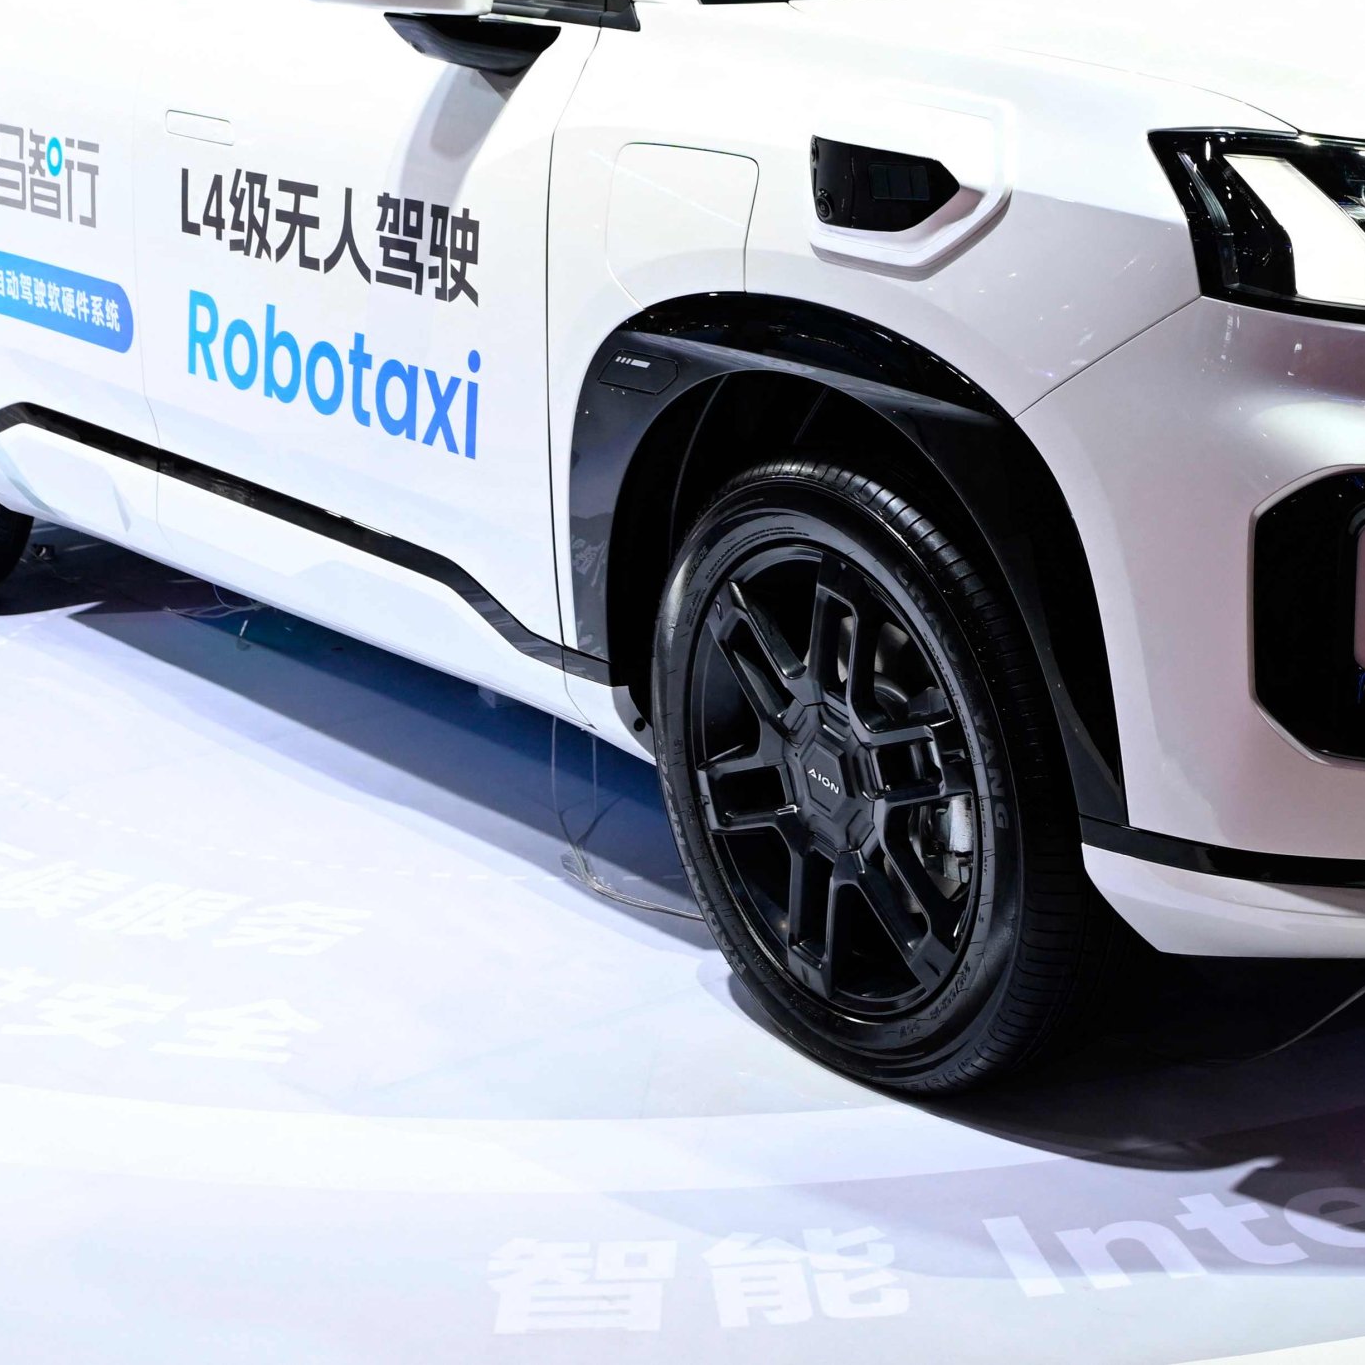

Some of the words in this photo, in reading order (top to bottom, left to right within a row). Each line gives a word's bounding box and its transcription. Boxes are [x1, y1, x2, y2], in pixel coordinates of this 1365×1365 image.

[180, 167, 481, 307] L4级无人驾驶
[186, 289, 482, 460] Robotaxi
[808, 768, 839, 794] AION
[487, 1223, 910, 1336] 智能
